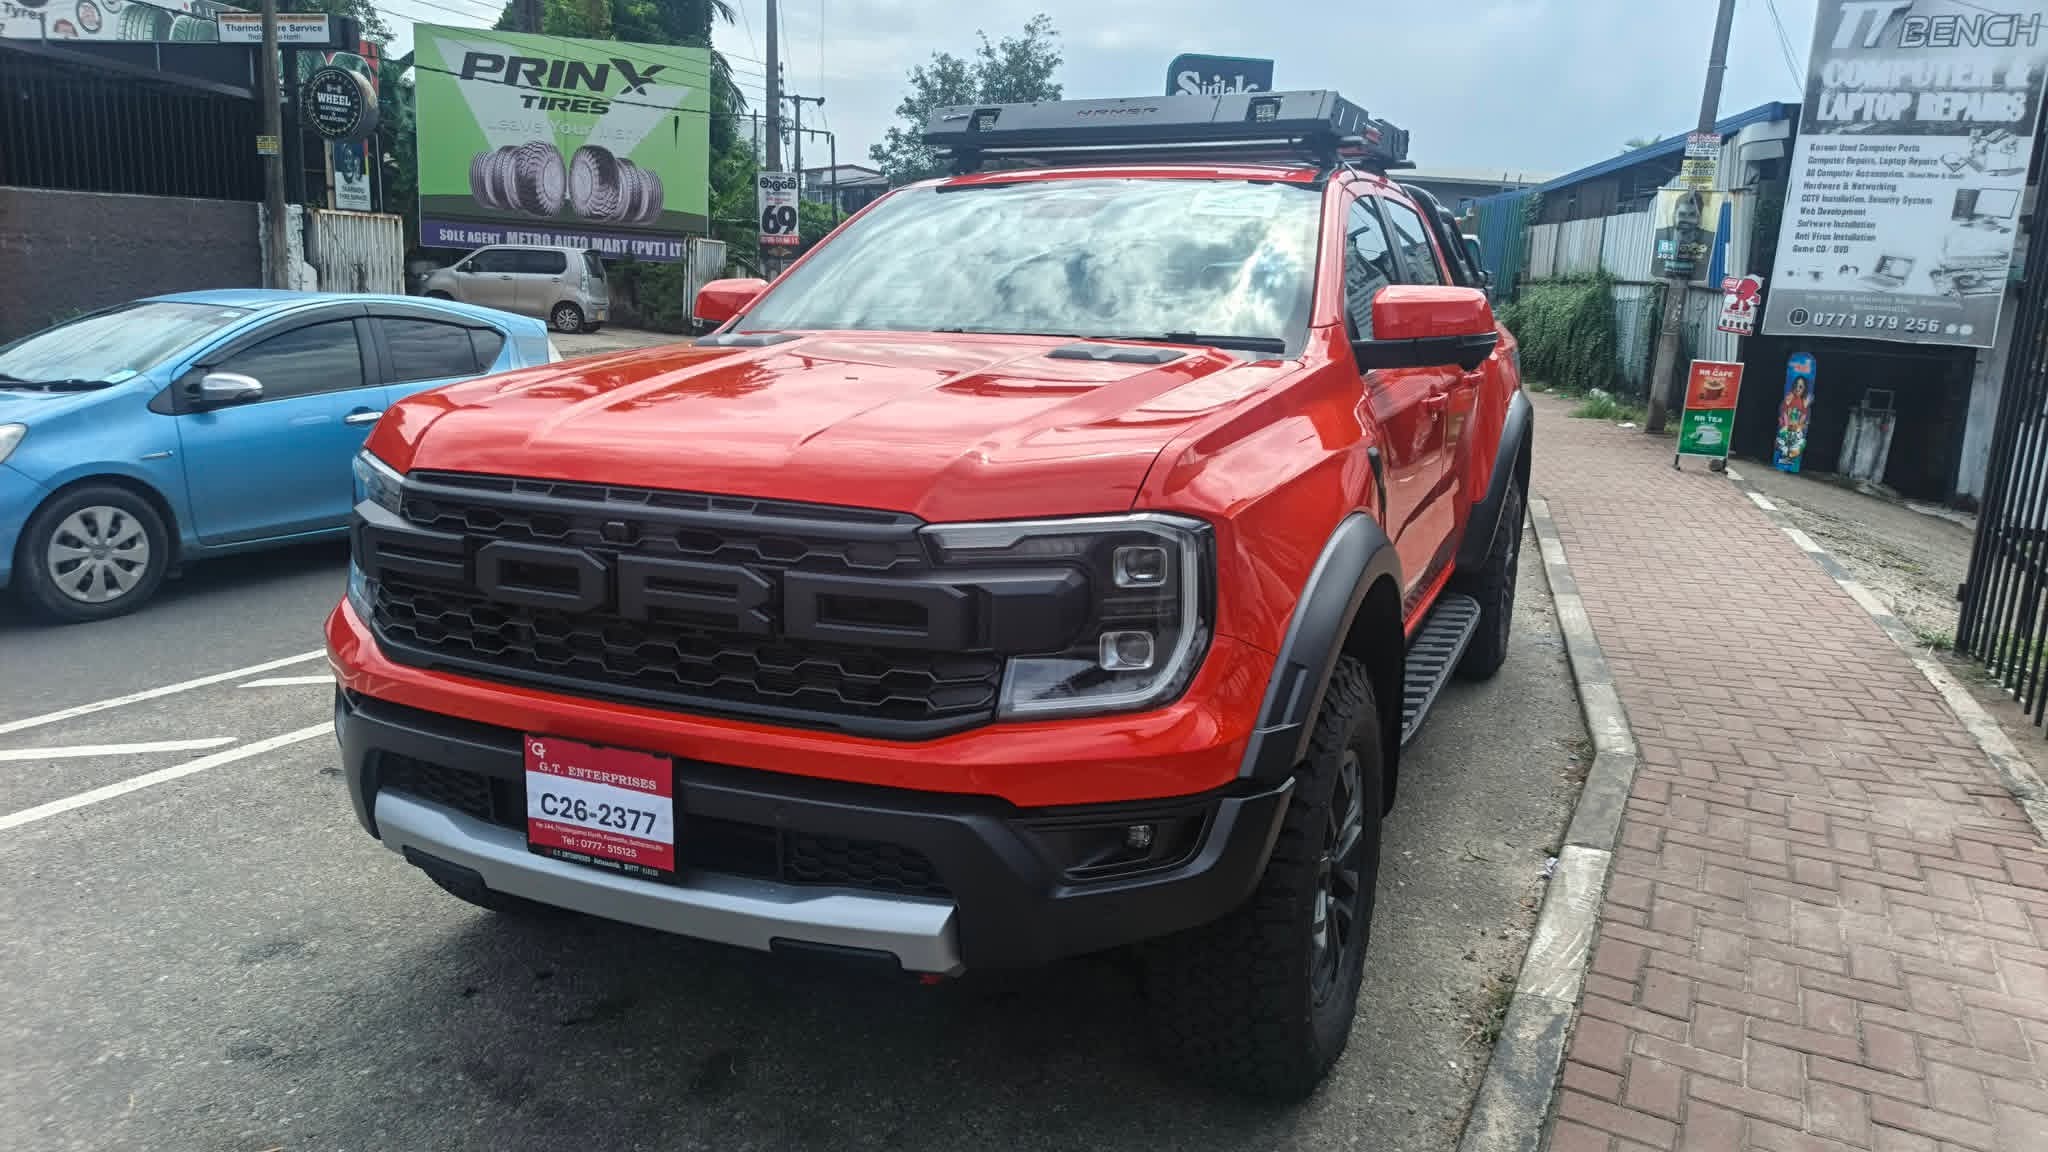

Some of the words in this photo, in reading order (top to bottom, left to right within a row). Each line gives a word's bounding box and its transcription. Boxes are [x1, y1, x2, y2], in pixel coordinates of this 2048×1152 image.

[289, 24, 323, 32] Service
[1898, 12, 2041, 49] BENCH
[459, 51, 667, 96] PRINX
[317, 92, 351, 107] WHEEL
[519, 94, 611, 115] TIRES
[1816, 91, 1913, 121] LAPTOP
[1859, 143, 1896, 153] Computer
[1808, 156, 1844, 166] Computer
[1879, 157, 1906, 167] Laptop
[1817, 169, 1853, 178] Computer
[1803, 181, 1841, 191] Hardware
[1800, 207, 1816, 216] Web
[1817, 207, 1866, 217] Development
[761, 205, 797, 235] 69
[1797, 219, 1832, 228] Software
[439, 228, 465, 242] SOLE
[467, 231, 501, 246] AGENT
[506, 231, 551, 247] METRO
[591, 237, 628, 255] MART
[670, 241, 685, 257] LT
[1795, 231, 1810, 240] Anti
[1812, 232, 1832, 241] Virus
[1813, 311, 1857, 327] 0771
[1864, 314, 1898, 329] 879
[1904, 317, 1941, 333] 256
[539, 761, 564, 775] G.T.
[568, 765, 657, 790] ENTERPRISES
[540, 792, 657, 835] C26-2377
[607, 844, 637, 859] 515125
